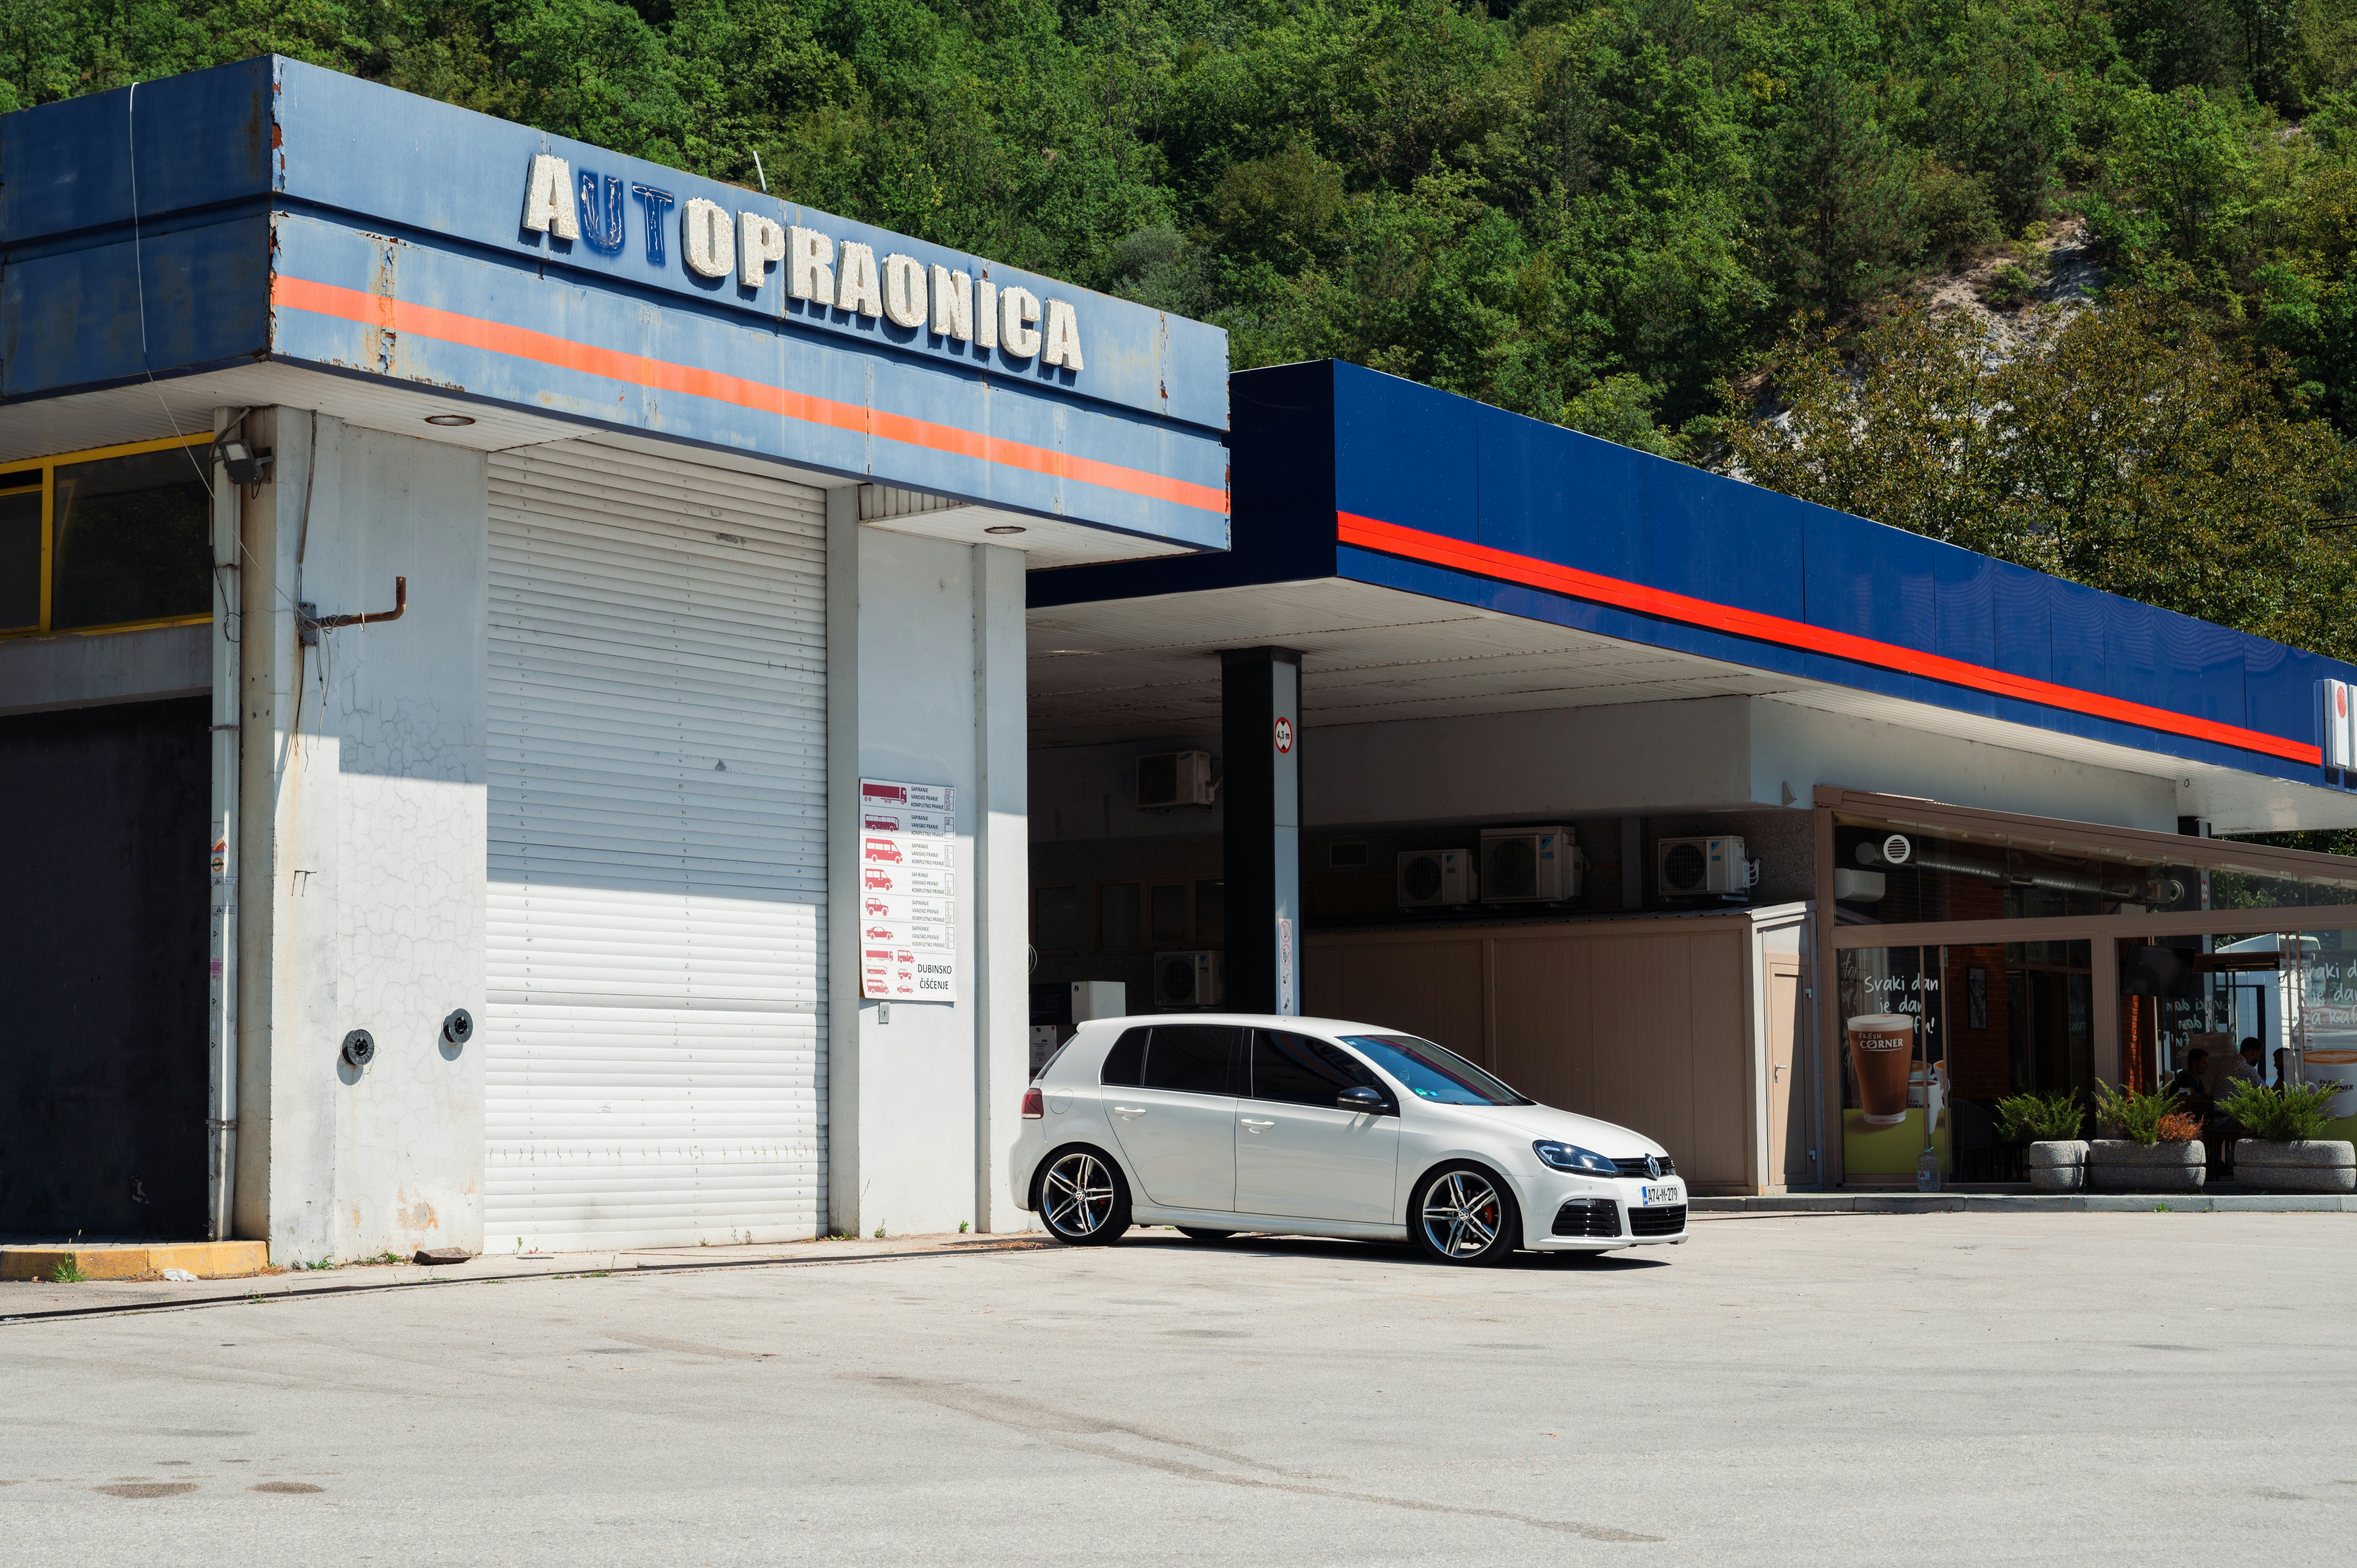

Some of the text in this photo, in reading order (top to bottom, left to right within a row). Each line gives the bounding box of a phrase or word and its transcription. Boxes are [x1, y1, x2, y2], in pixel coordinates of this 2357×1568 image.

[522, 154, 1083, 372] AUTOPRAONICA
[918, 964, 952, 974] DUBINSKO
[920, 977, 949, 989] ČIŠĆENJE
[1864, 973, 1938, 993] Svaki dan
[2334, 982, 2357, 1001] da
[1880, 997, 1892, 1014] je
[2302, 1005, 2357, 1026] za kaf
[1860, 1038, 1903, 1049] CORNER
[1648, 1187, 1677, 1202] A74-M-279
